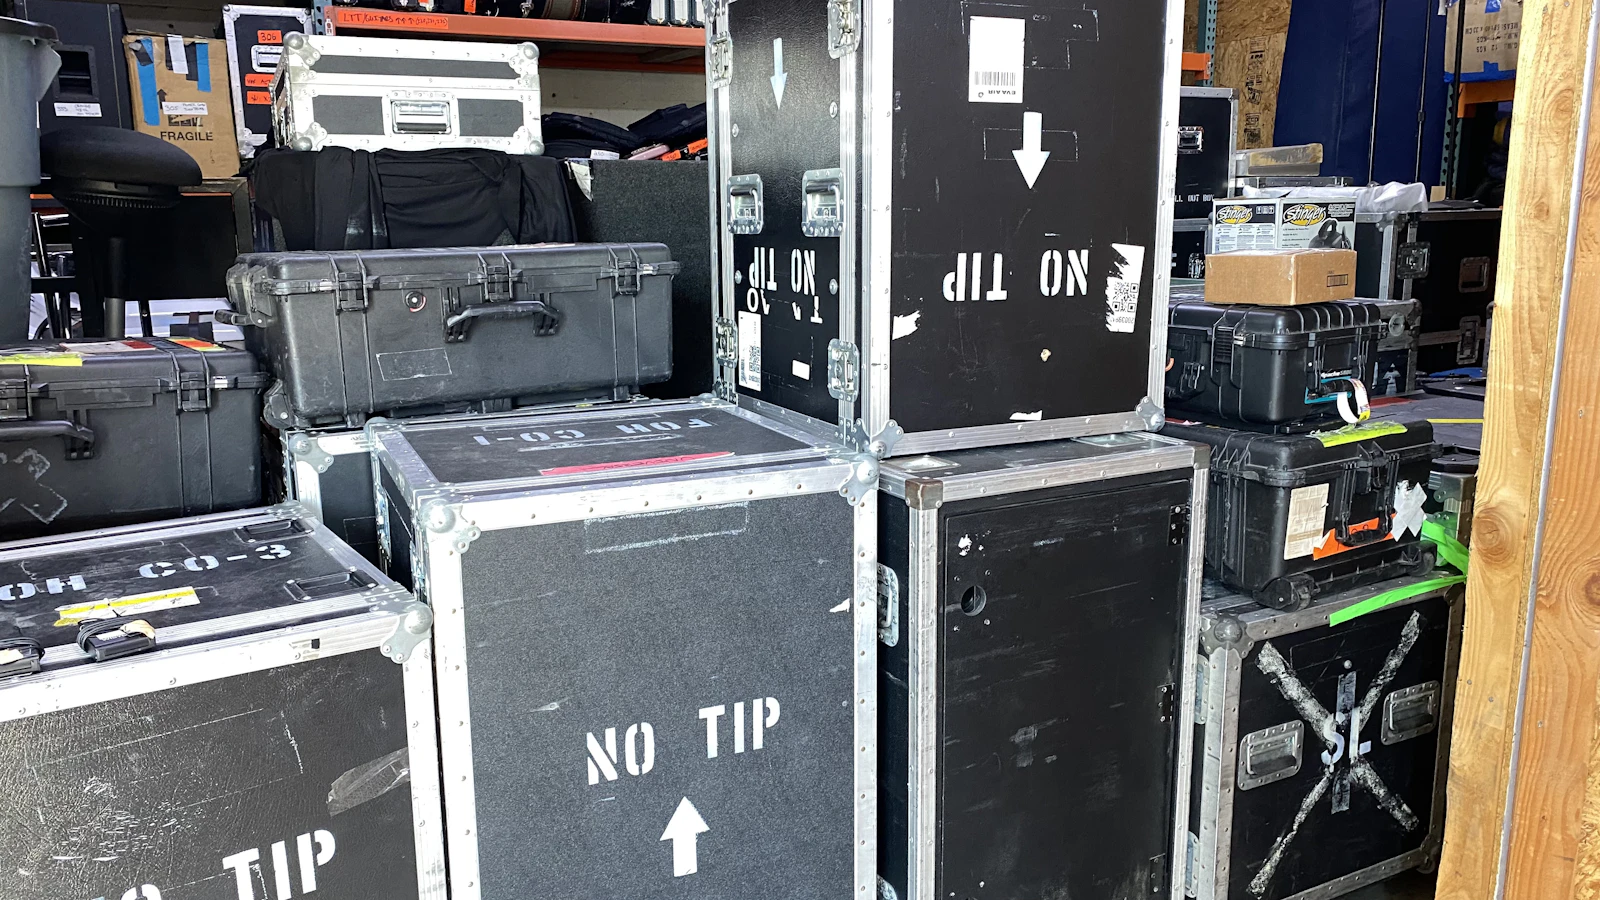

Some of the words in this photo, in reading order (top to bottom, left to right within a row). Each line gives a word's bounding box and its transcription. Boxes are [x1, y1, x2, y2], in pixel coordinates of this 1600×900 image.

[260, 32, 277, 42] 306
[160, 131, 214, 142] FRAGILE
[1217, 205, 1253, 223] Stinger
[1283, 203, 1327, 227] Stinger
[748, 246, 778, 292] TIP
[790, 248, 816, 296] NO
[943, 252, 1008, 302] TIP
[1039, 249, 1089, 297] NO
[615, 417, 713, 434] FOH
[0, 575, 87, 602] OH
[138, 544, 292, 579] CO-3
[586, 721, 655, 786] NO
[698, 696, 782, 760] TIP
[1320, 706, 1373, 768] SL
[222, 829, 336, 900] TIP
